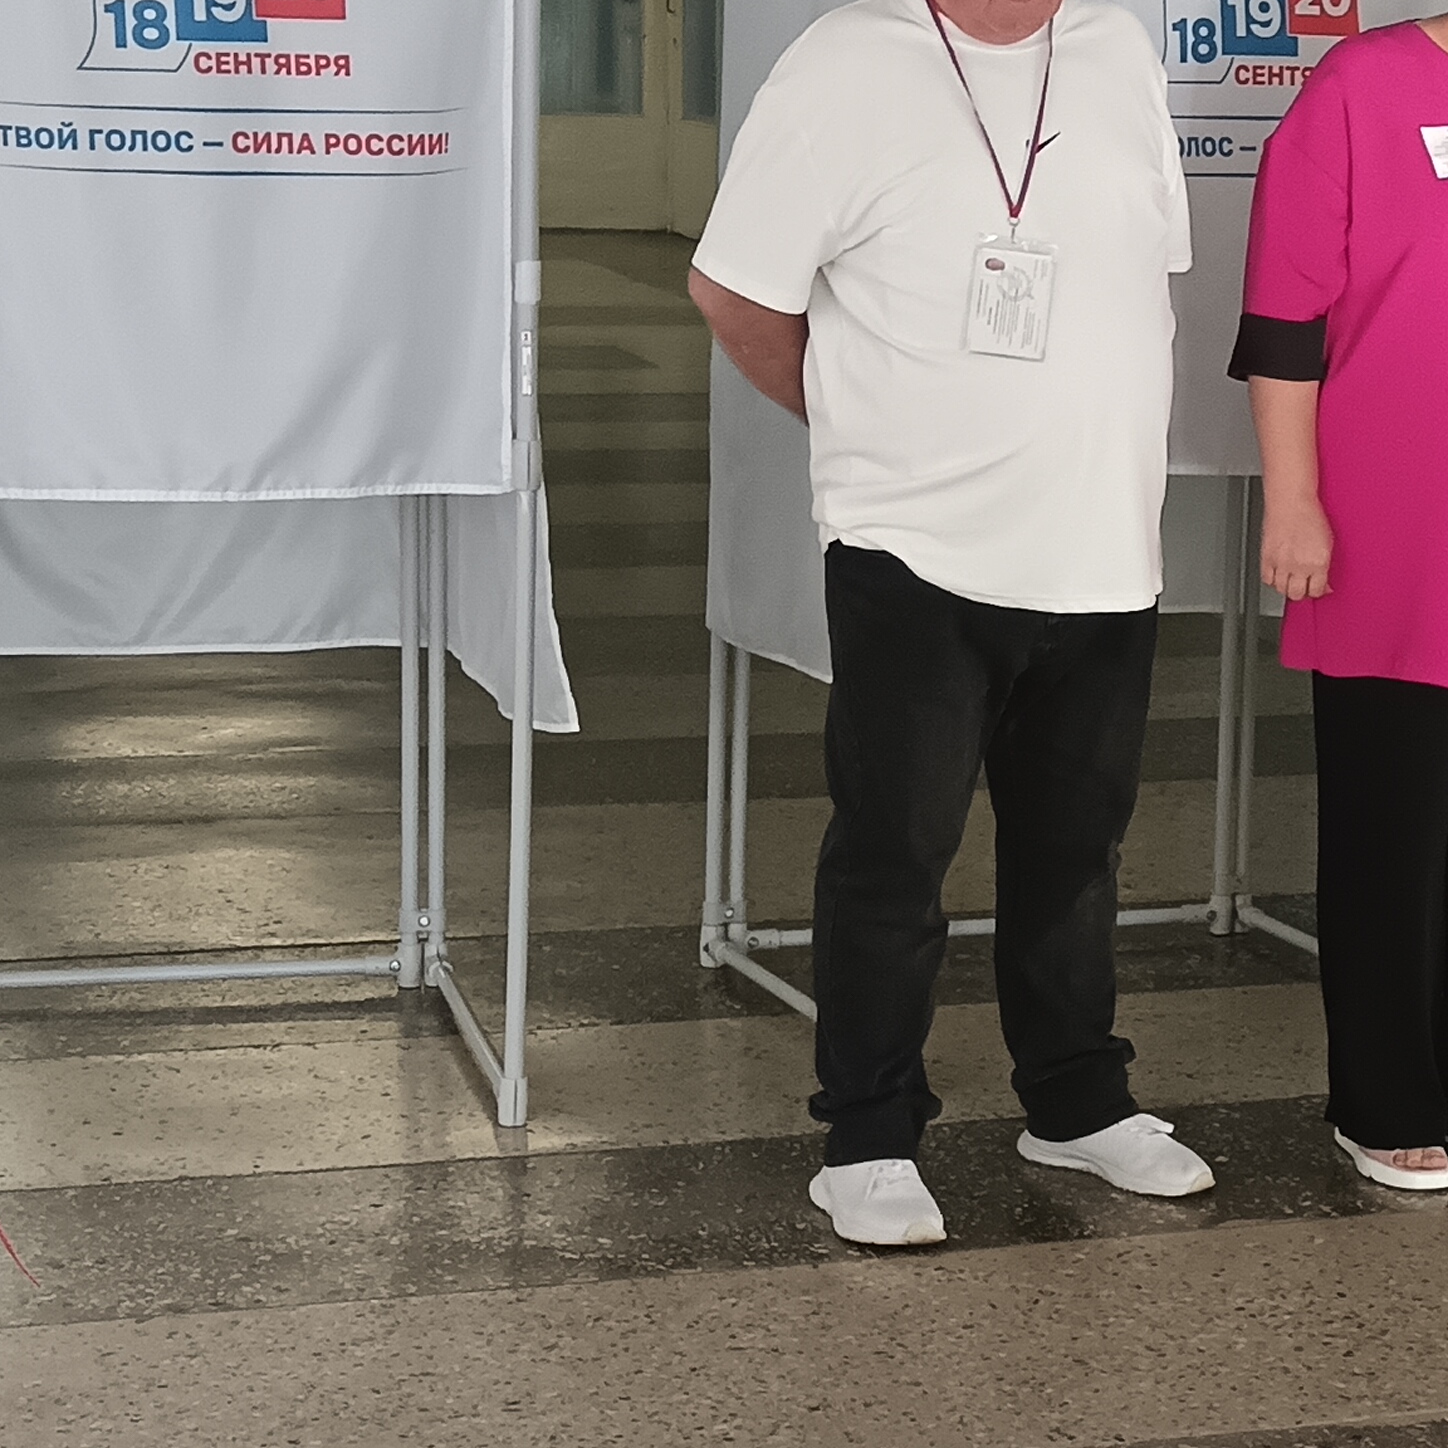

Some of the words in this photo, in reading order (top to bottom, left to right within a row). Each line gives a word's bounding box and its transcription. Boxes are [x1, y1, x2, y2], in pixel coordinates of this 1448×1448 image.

[1171, 17, 1219, 65] 18
[193, 50, 352, 78] СЕНТЯБРЯ
[87, 127, 195, 154] ГОЛОС
[230, 130, 319, 156] СИЛА
[323, 131, 450, 157] РОССИИ!
